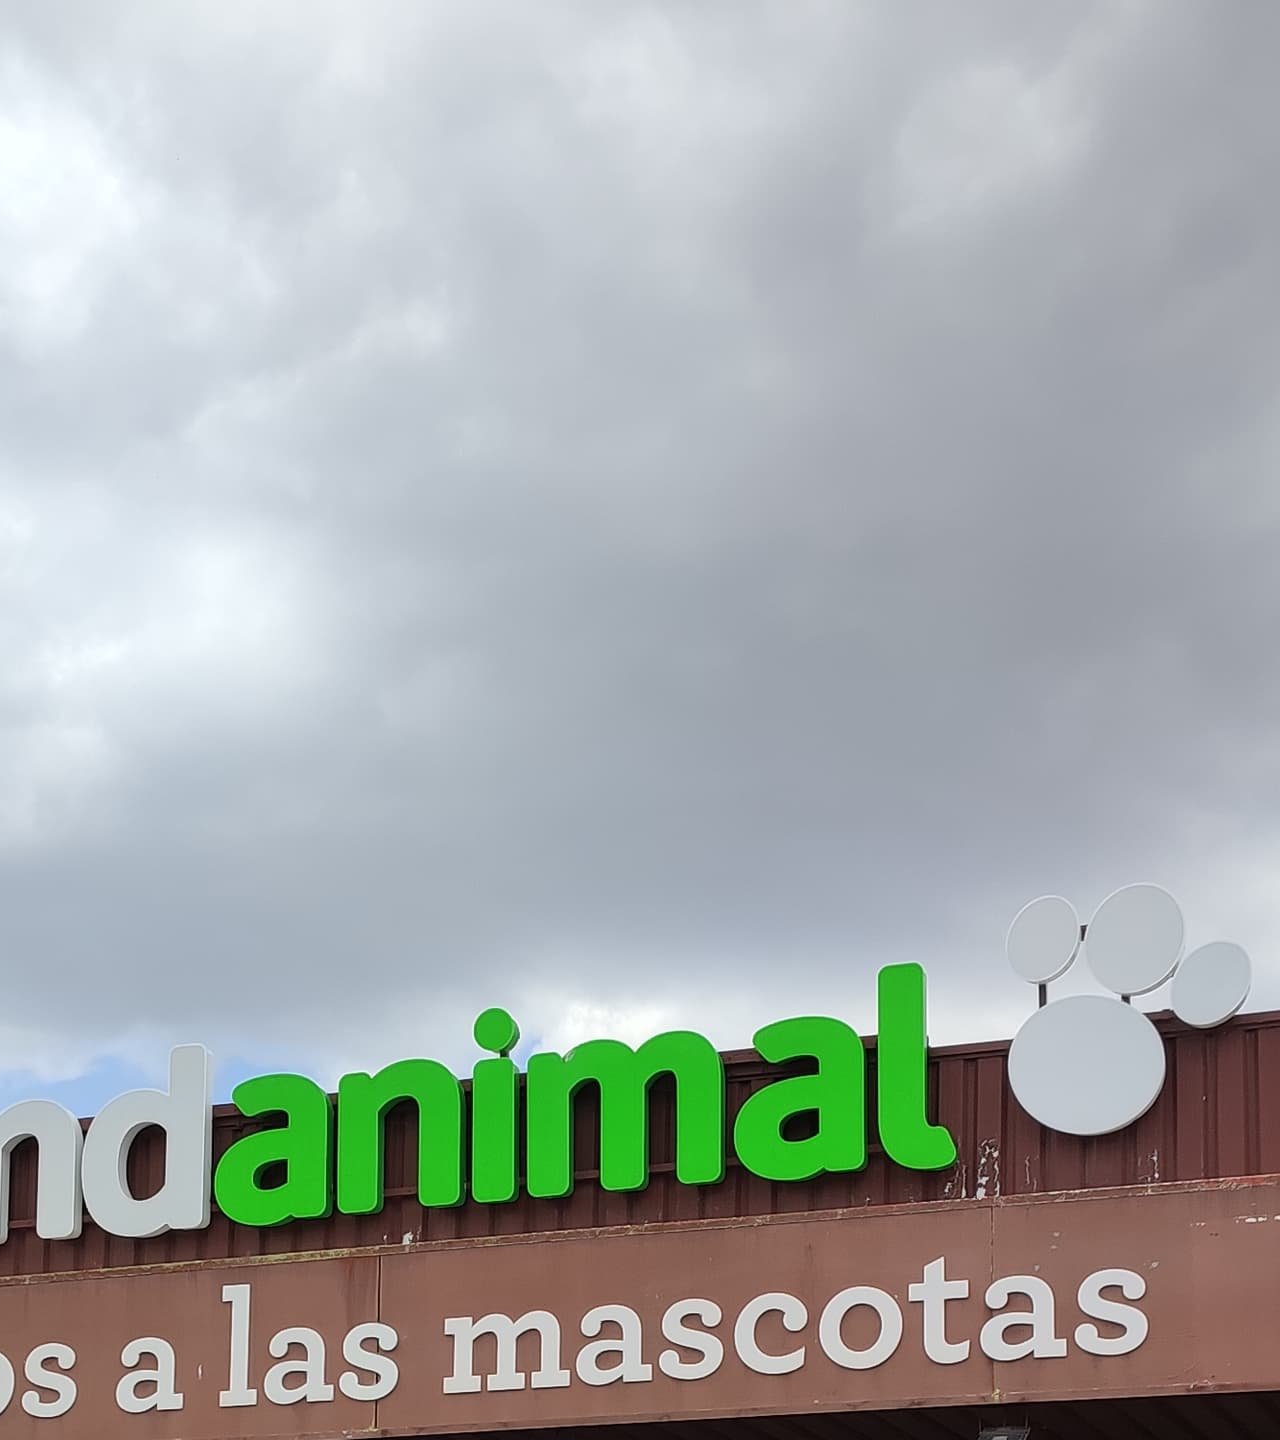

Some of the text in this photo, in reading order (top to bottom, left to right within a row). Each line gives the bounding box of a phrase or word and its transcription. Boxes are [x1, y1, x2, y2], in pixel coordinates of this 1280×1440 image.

[115, 1335, 184, 1415] a
[219, 1282, 401, 1408] las
[442, 1255, 1149, 1396] mascotas
